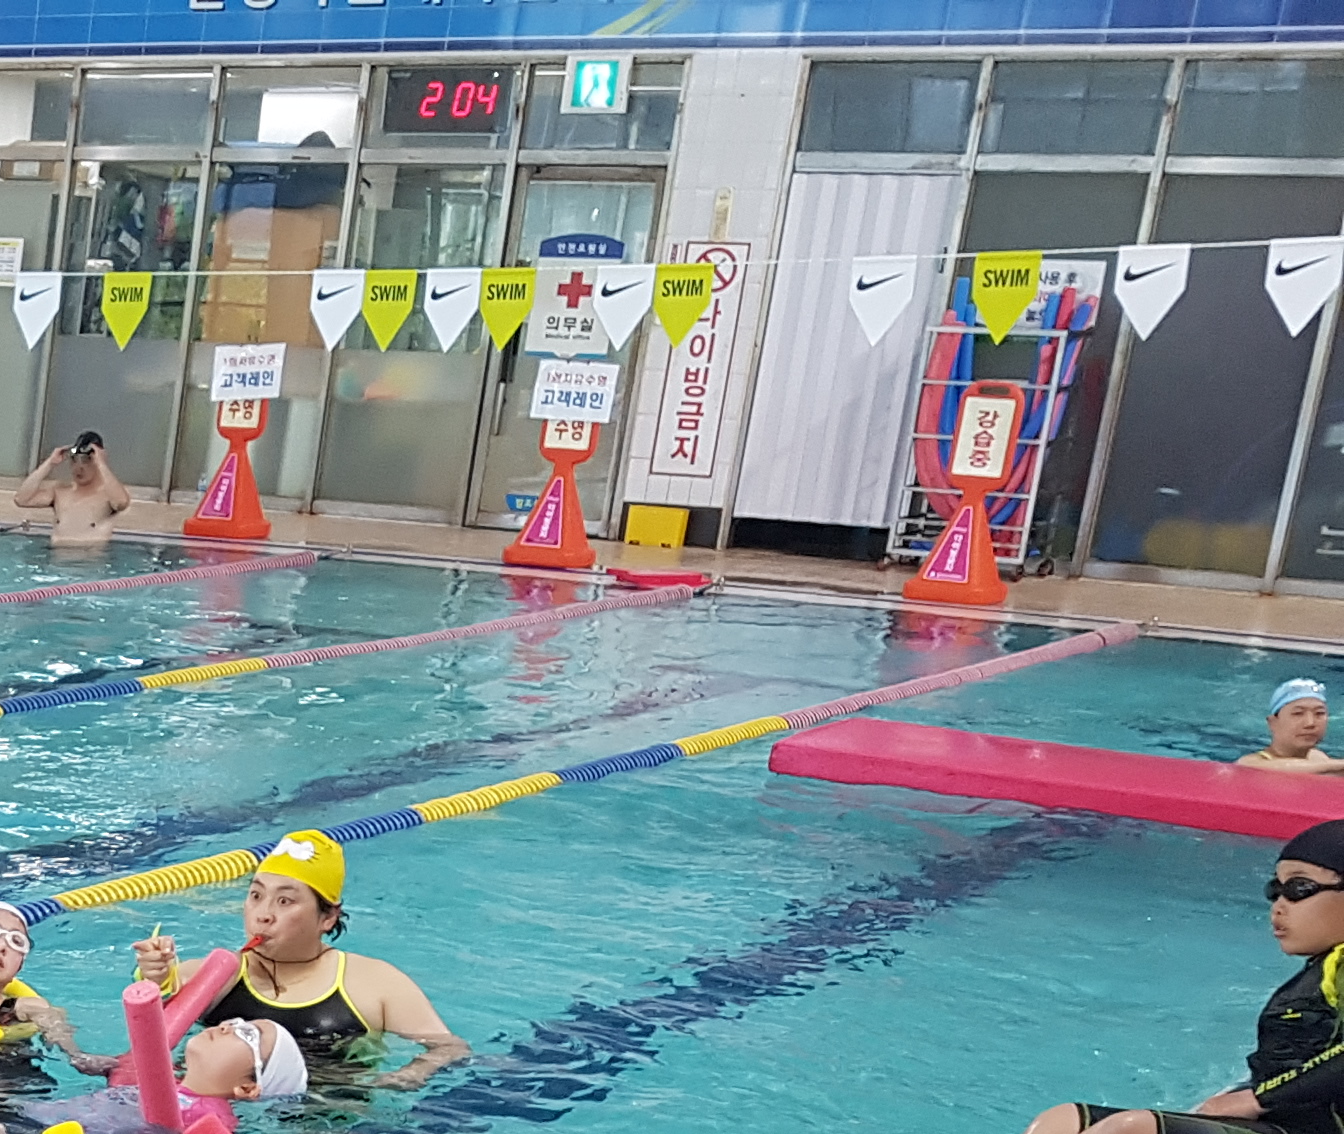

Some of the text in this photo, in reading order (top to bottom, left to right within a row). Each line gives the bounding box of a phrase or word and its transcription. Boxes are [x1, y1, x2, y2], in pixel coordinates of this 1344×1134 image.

[982, 268, 1031, 288] SWIM
[110, 286, 144, 303] SWIM
[370, 284, 408, 302] SWIM
[487, 282, 527, 301] SWIM
[662, 279, 704, 297] SWIM
[546, 315, 595, 333] 의무실
[220, 370, 275, 388] 고객레인
[540, 388, 604, 410] 고객레인
[554, 420, 585, 441] 수영
[968, 409, 1000, 469] 강습중
